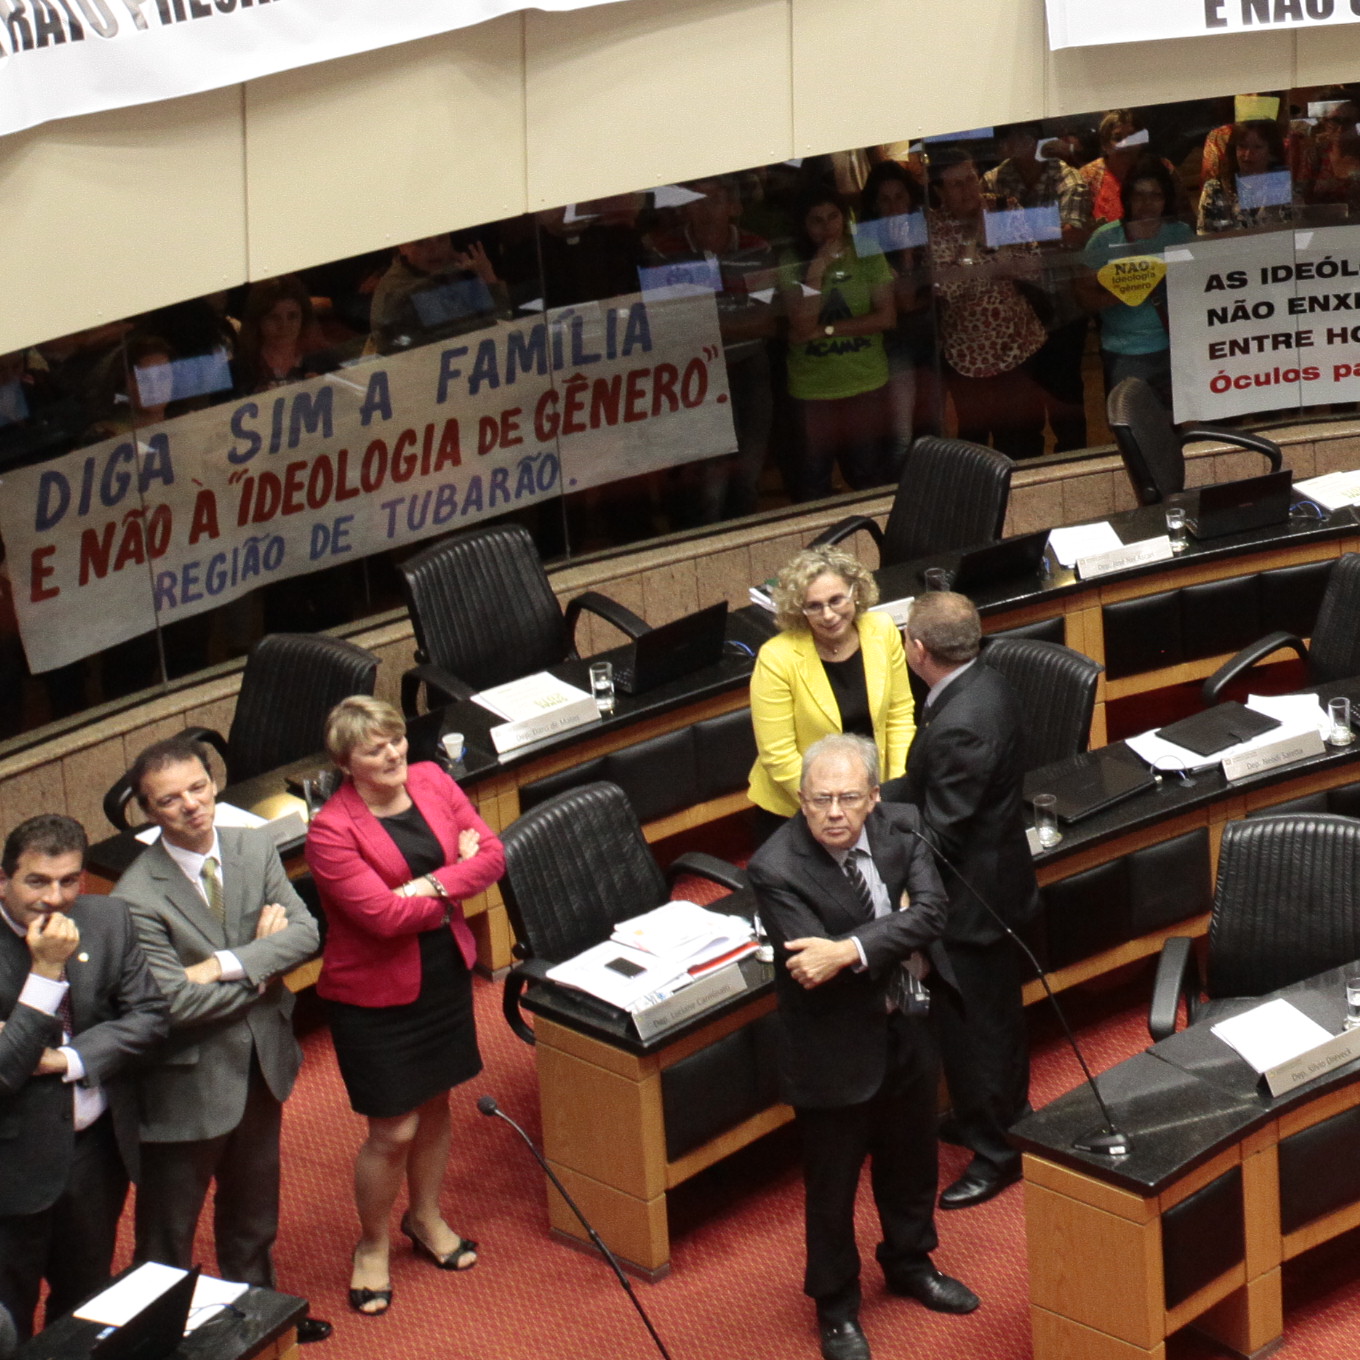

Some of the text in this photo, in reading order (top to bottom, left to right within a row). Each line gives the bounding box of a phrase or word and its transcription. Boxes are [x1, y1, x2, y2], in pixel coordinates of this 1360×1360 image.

[1204, 271, 1249, 293] AS
[1207, 298, 1275, 328] NÃO
[1208, 330, 1314, 362] ENTRE
[1209, 362, 1322, 396] Óculos
[34, 301, 654, 532] DIGA SIM A FAMÍLIA
[29, 544, 61, 604] E
[77, 500, 173, 588] NÃO
[188, 477, 221, 546] À
[228, 417, 463, 528] "IDEOLOGIA
[476, 408, 525, 456] DE
[153, 452, 580, 614] REGIÃO DE TUBARÃO.
[1291, 1071, 1306, 1082] Dep.
